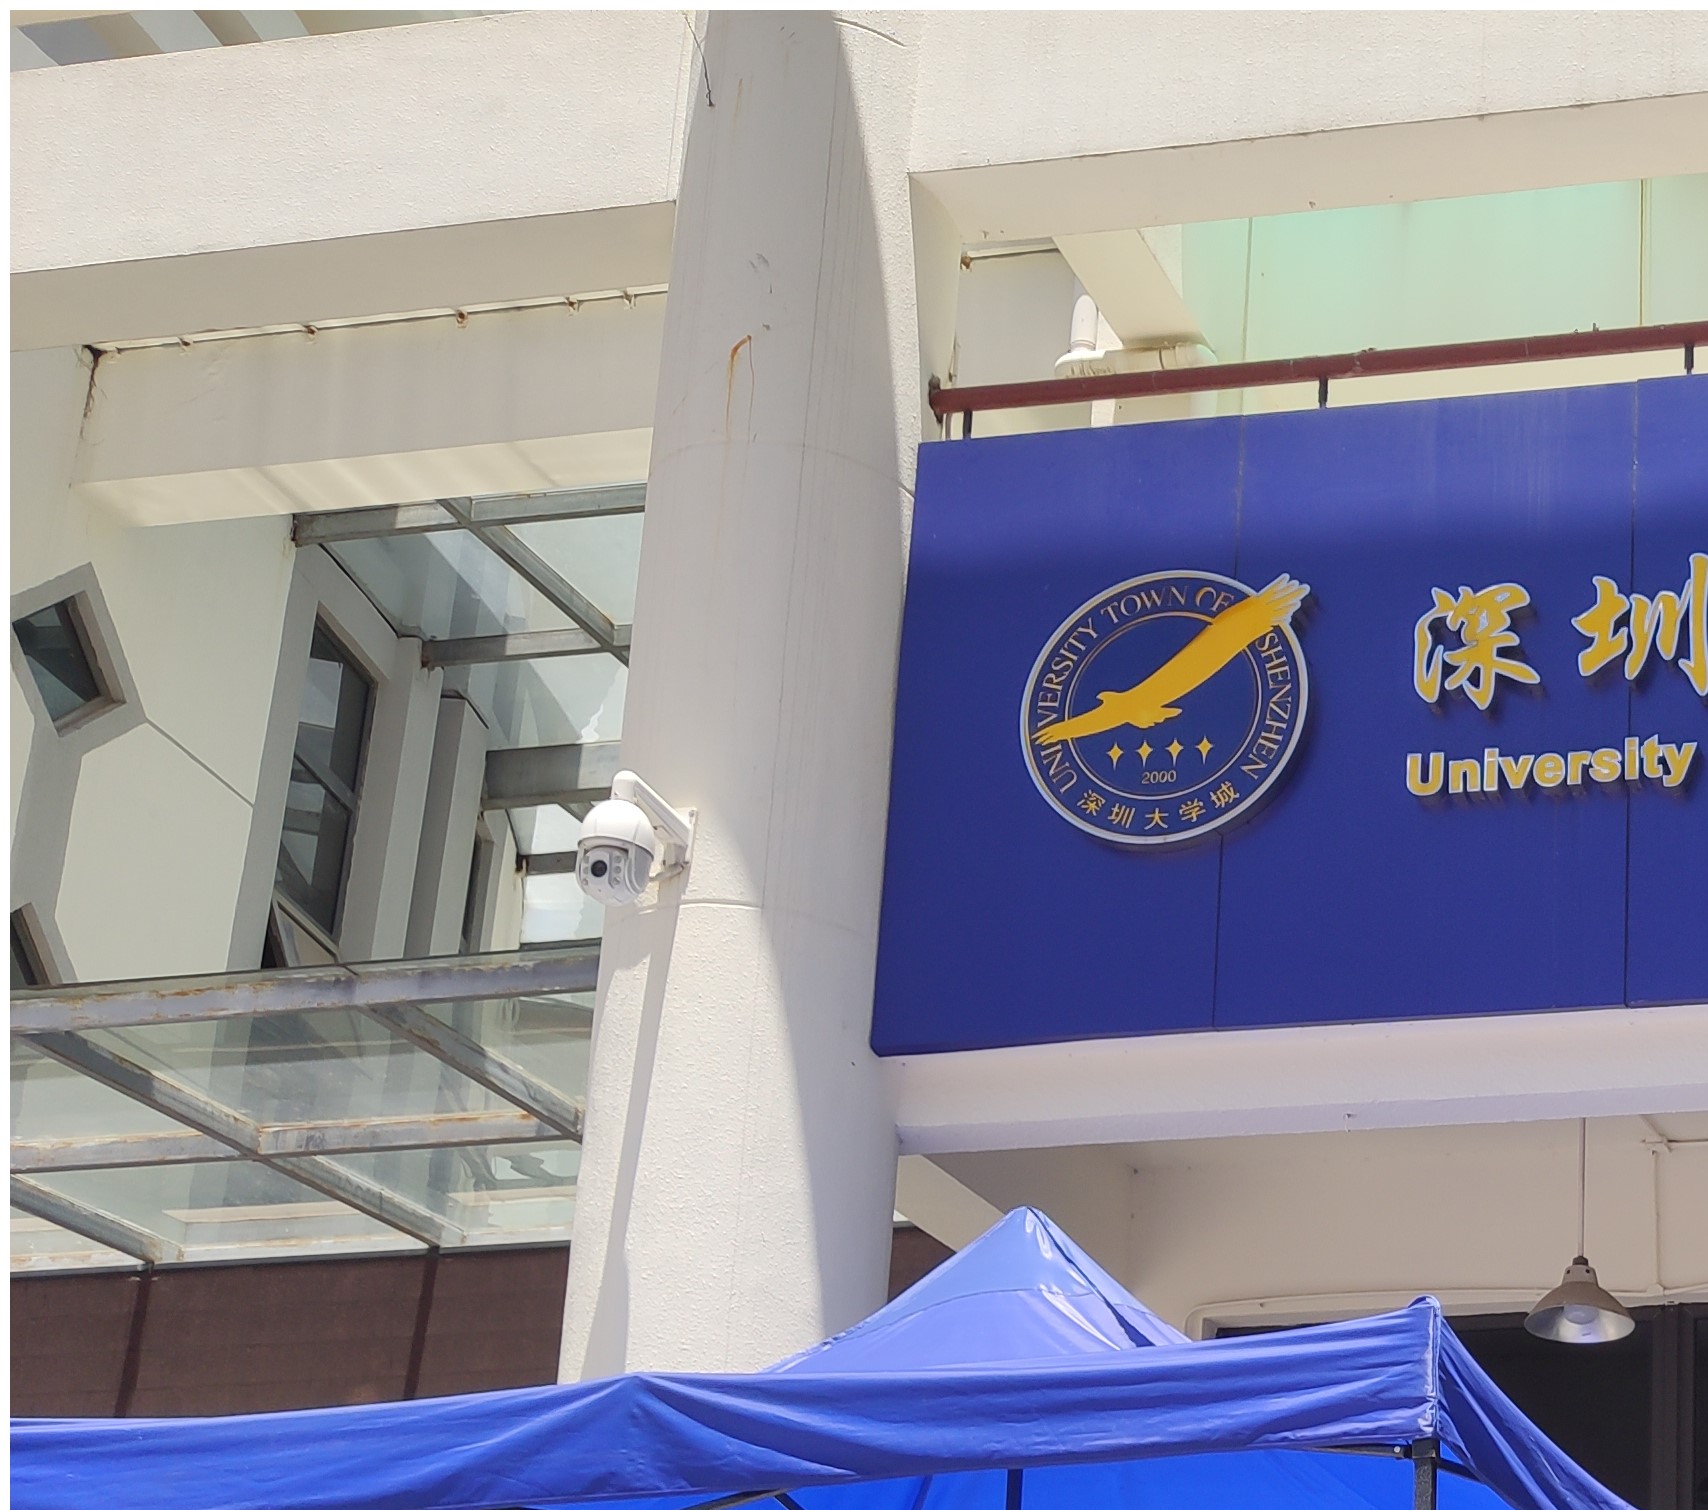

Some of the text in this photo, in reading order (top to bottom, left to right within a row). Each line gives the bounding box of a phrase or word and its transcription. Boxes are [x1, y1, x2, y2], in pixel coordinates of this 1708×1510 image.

[1100, 586, 1188, 625] TOWN
[1240, 632, 1292, 780] SHENZHEN
[1141, 770, 1177, 784] 2000
[1405, 737, 1695, 800] University
[1077, 780, 1240, 830] 深圳大学城
